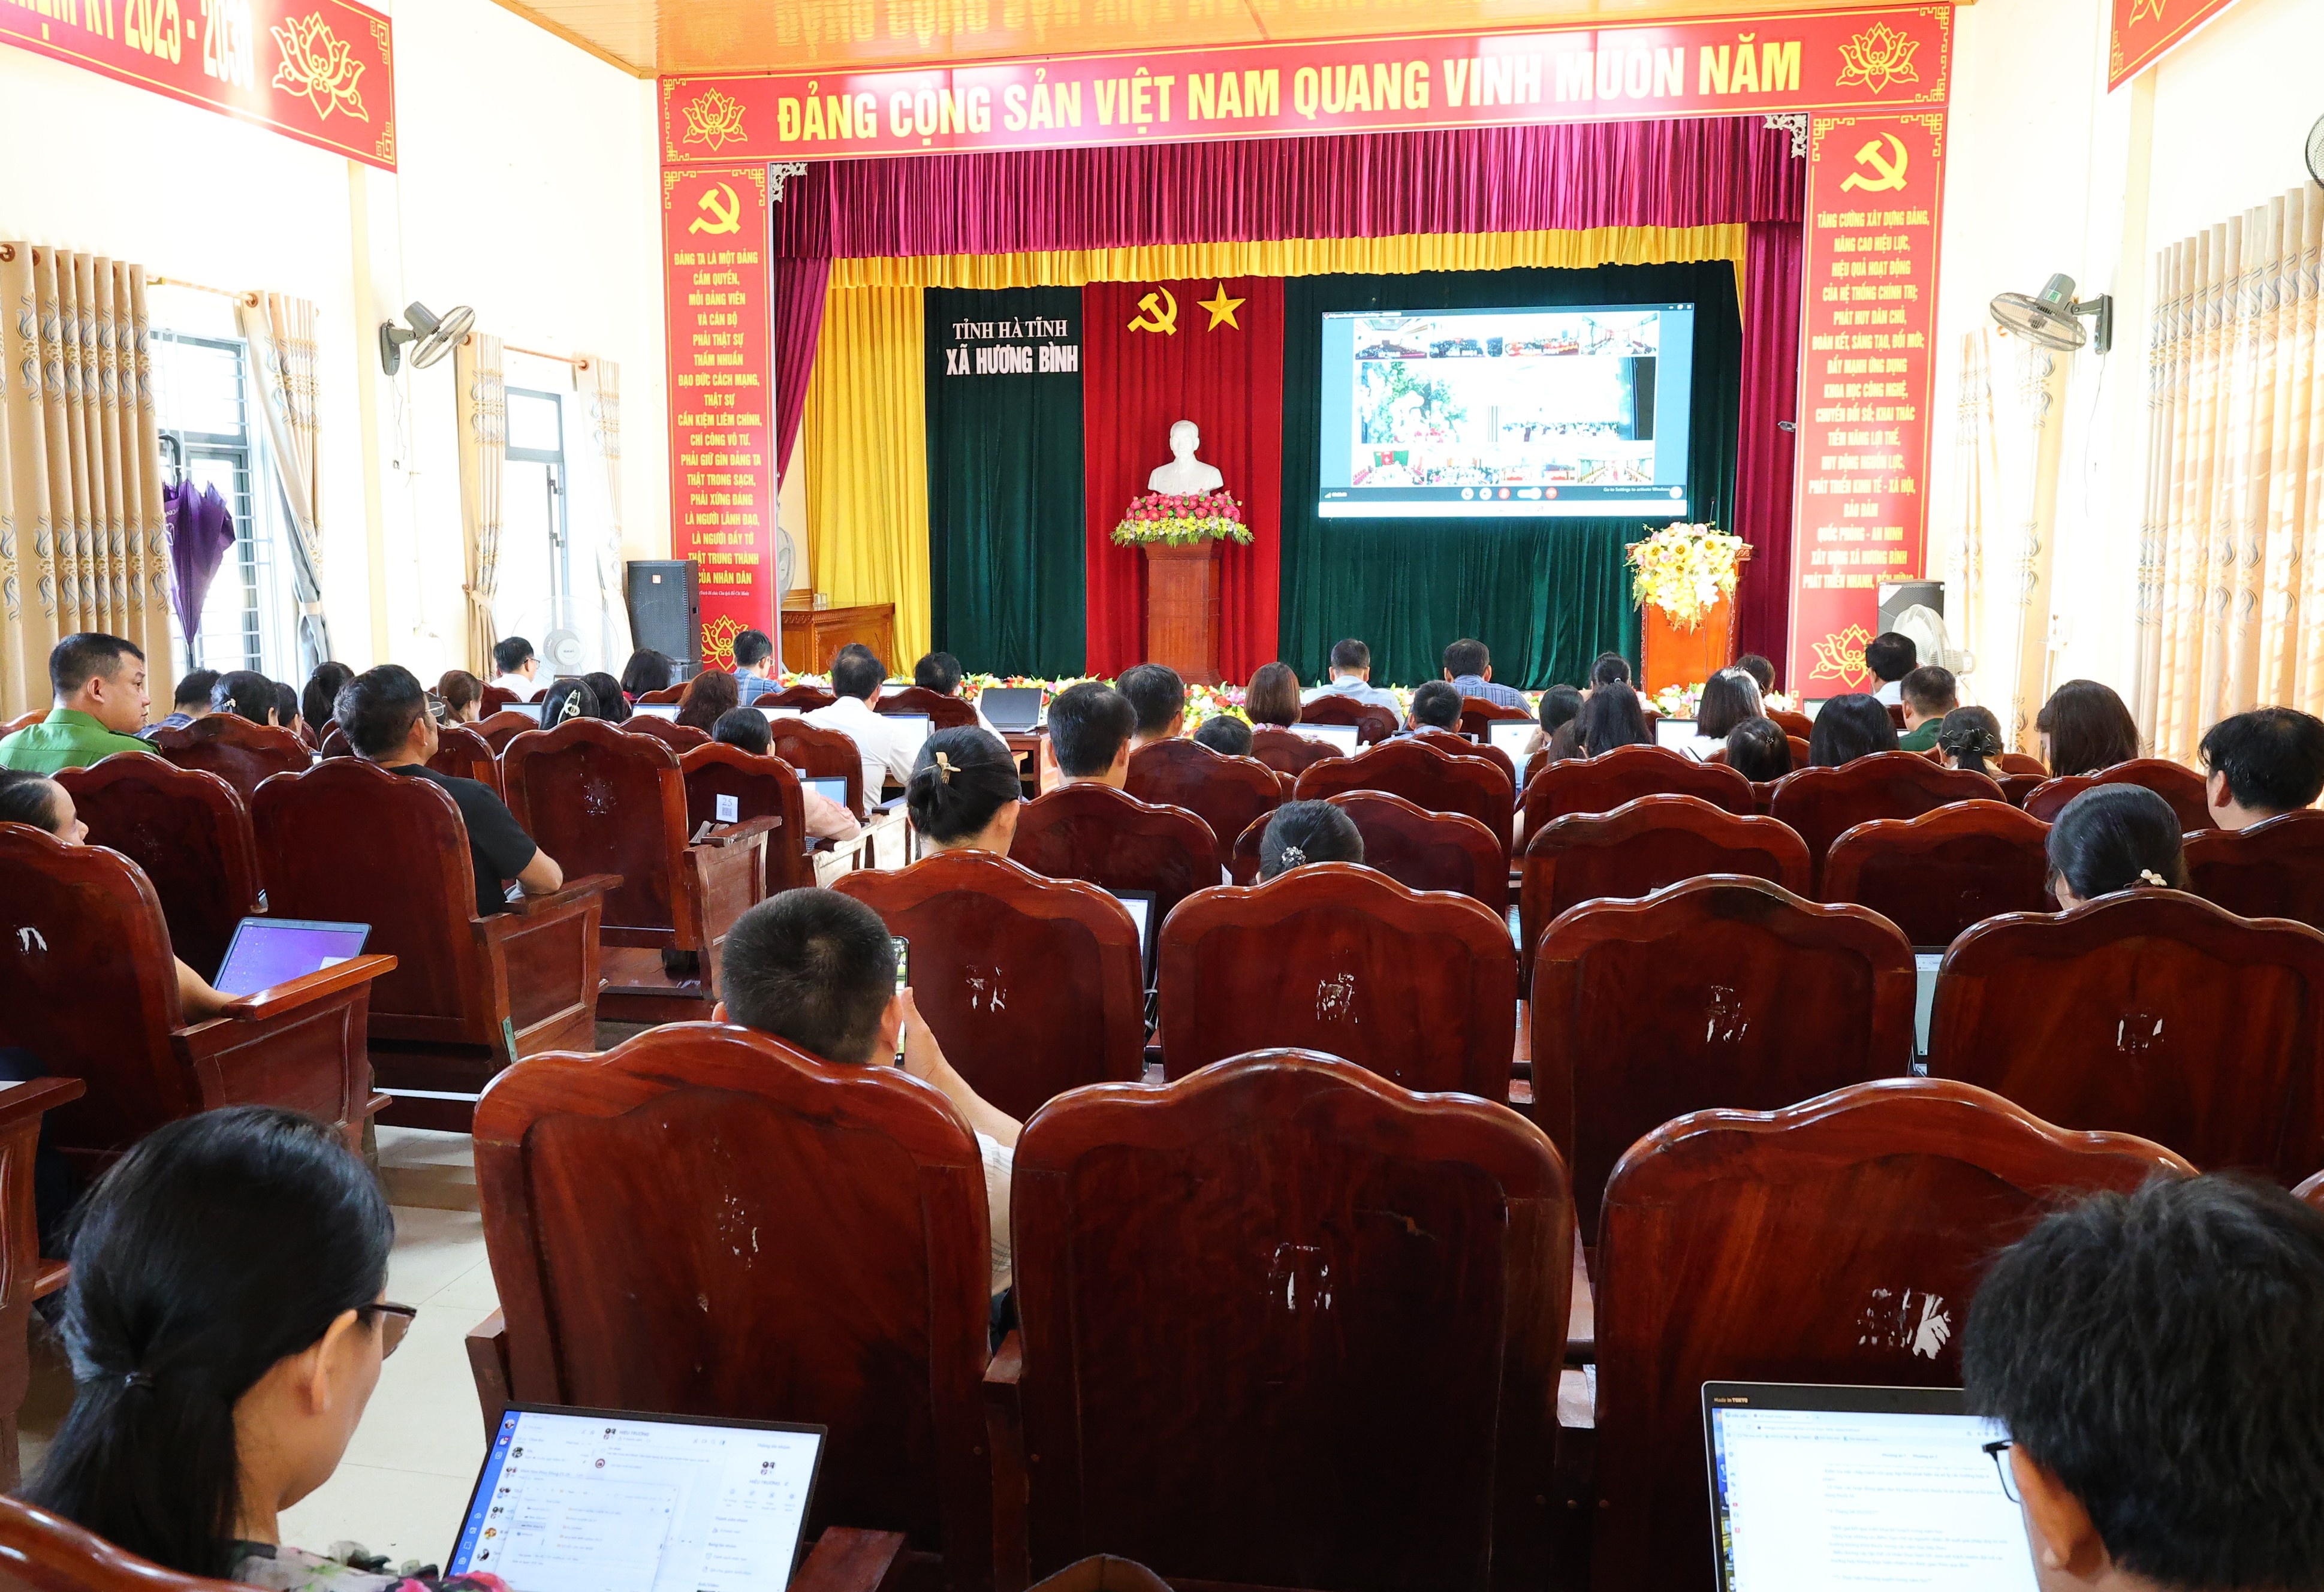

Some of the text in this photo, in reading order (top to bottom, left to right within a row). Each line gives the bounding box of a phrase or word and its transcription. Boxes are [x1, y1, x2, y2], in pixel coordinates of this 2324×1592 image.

[777, 32, 1802, 145] ĐẢNG CỘNG SẢN VIỆT NAM QUANG VINH MUÔN NĂM
[1817, 206, 1930, 229] TĂNG CƯỜNG XÂY DỰNG ĐẢNG,
[1834, 233, 1910, 254] NÂNG CAO HIỆU LỰC,
[674, 248, 758, 267] ĐẢNG TA LÀ MỘT ĐẢNG
[1831, 257, 1911, 279] HIỆU QUẢ HOẠT ĐỘNG
[705, 290, 727, 306] ĐẢNG
[728, 290, 746, 305] VIÊN
[1822, 281, 1918, 303] CỦA HỆ THỐNG CHÍNH TRỊ;
[697, 310, 737, 328] VÀ CÁN BỘ
[1833, 305, 1907, 325] PHÁT HUY DÂN CHỦ,
[952, 316, 1068, 339] TỈNH HÀ TĨNH
[693, 330, 744, 348] PHẢI THẬT SỰ
[1811, 329, 1924, 351] ĐOÀN KẾT, SÁNG TẠO, ĐỔI MỚI;
[694, 350, 715, 366] THẤM
[946, 341, 1078, 375] XÃ HƯƠNG BÌNH
[1827, 355, 1907, 376] ĐẨY MẠNH ỨNG DỤNG
[678, 372, 760, 389] ĐẠO ĐỨC CÁCH MẠNG,
[1823, 379, 1909, 401] KHOA HỌC CÔNG NGHỆ,
[704, 391, 736, 409] THẬT SỰ
[695, 412, 715, 429] KIỆM
[716, 412, 735, 426] LIÊM
[736, 412, 762, 427] CHÍNH,
[1815, 402, 1915, 423] CHUYỂN ĐỔI SỐ; KHAI THÁC
[691, 432, 750, 446] CHÍ CÔNG VÔ TƯ.
[1847, 429, 1870, 446] NĂNG
[1870, 429, 1883, 449] LỢI
[1884, 427, 1901, 447] THẾ,
[681, 450, 698, 466] PHẢI
[715, 451, 728, 466] GÌN
[730, 450, 751, 466] ĐẢNG
[752, 454, 761, 466] TA
[687, 471, 756, 488] THẬT TRONG SẠCH,
[1808, 477, 1829, 495] PHÁT
[1852, 479, 1872, 493] KINH
[1873, 474, 1883, 494] TẾ
[1888, 476, 1899, 493] XÃ
[1900, 476, 1916, 496] HỘI,
[691, 490, 708, 505] PHẢI
[732, 492, 753, 506] ĐÁNG
[685, 511, 760, 528] LÀ NGƯỜI LÃNH ĐẠO,
[692, 530, 701, 544] LÀ
[703, 530, 726, 545] NGƯỜI
[744, 531, 754, 545] TỚ
[1871, 526, 1883, 541] AN
[1883, 526, 1903, 541] NINH
[707, 552, 733, 565] TRUNG
[734, 550, 759, 565] THÀNH
[1810, 548, 1827, 565] XÂY
[1849, 548, 1861, 565] XÃ
[1888, 547, 1907, 565] BÌNH
[713, 570, 734, 584] NHÂN
[736, 570, 752, 584] DÂN
[722, 797, 733, 807] 25
